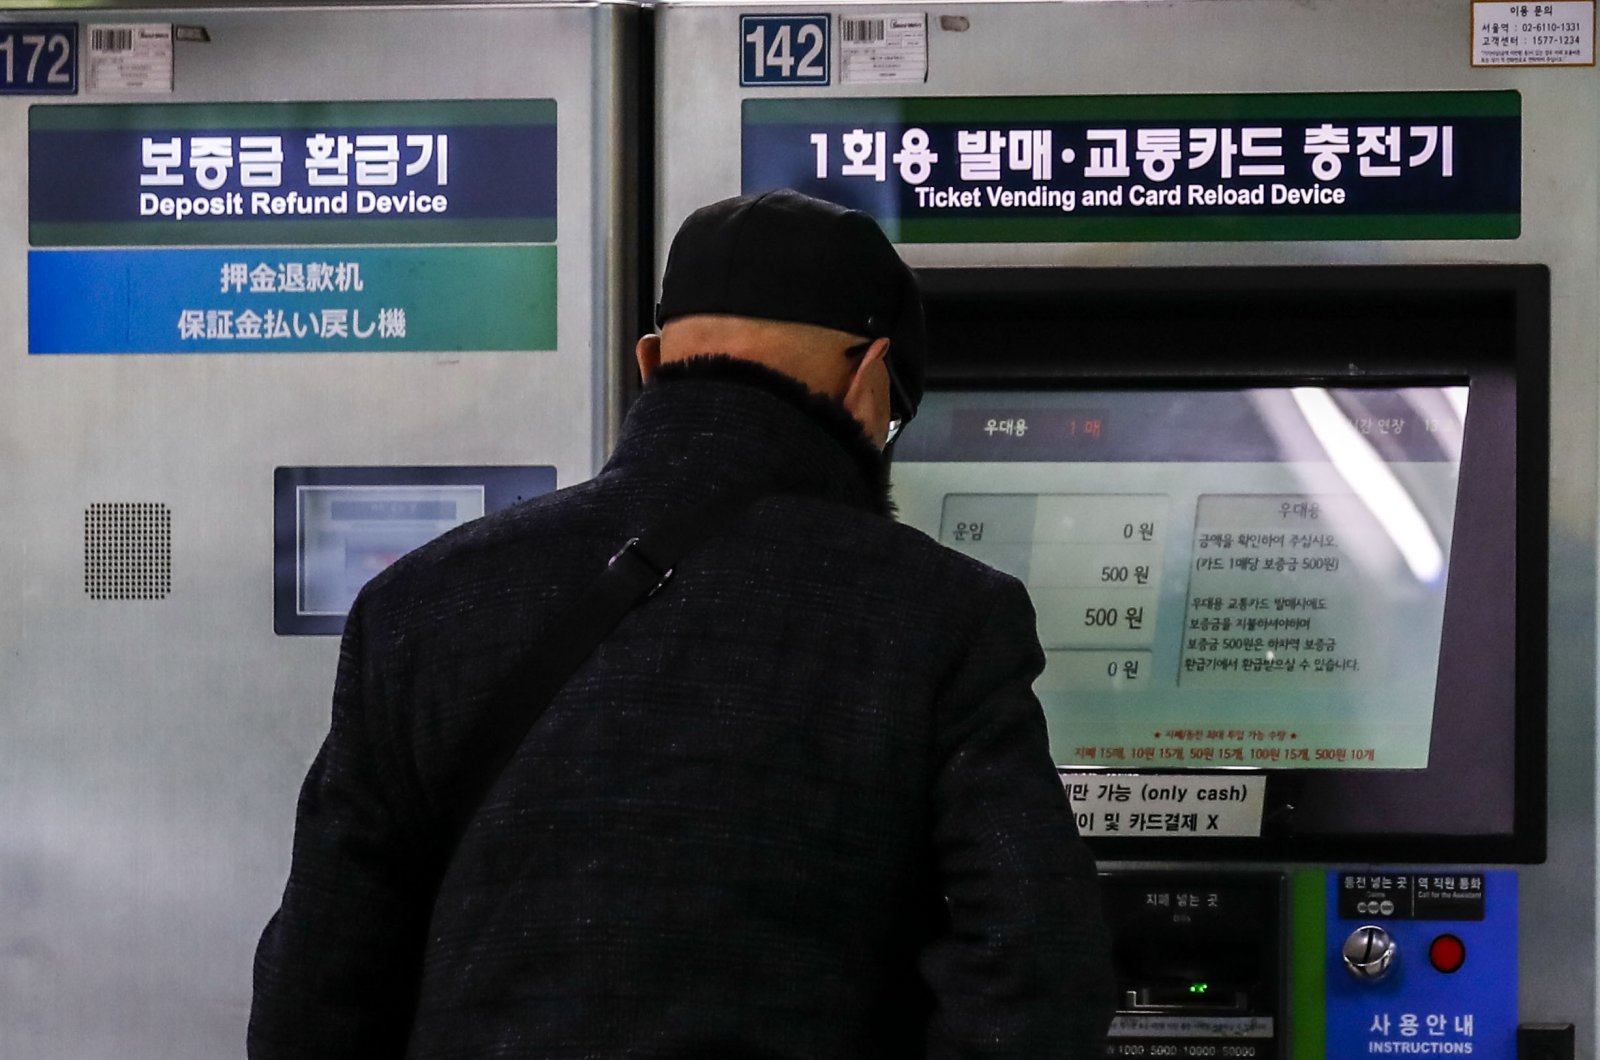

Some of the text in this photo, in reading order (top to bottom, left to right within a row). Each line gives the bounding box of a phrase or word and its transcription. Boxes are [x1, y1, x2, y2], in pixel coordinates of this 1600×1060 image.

[1510, 5, 1553, 17] 이용 문의
[1482, 22, 1509, 33] 서울역
[1522, 22, 1580, 32] 02-6110-1331
[1482, 36, 1518, 46] 고객센터
[1532, 36, 1580, 45] 1577-1234
[0, 34, 70, 83] 172
[746, 24, 824, 77] 142
[140, 133, 448, 190] 보증금 환급기
[1304, 124, 1453, 181] 충전기
[140, 190, 448, 219] Deposit Refund Device
[915, 183, 1346, 211] Ticket Vending and Card Reload Device
[220, 262, 363, 293] 押金退款机
[178, 309, 406, 340] 保証金払い戻し機
[984, 418, 1028, 437] 우대용
[1084, 419, 1102, 437] 매
[1378, 418, 1405, 434] 연장
[1278, 502, 1323, 519] 우대용
[953, 522, 1154, 541] 운임 0 원
[1198, 533, 1234, 548] 금액을
[1237, 533, 1285, 548] 확인하여
[1196, 557, 1340, 571] (카드 1매당 보증금 500원)
[1101, 565, 1149, 584] 500 원
[1227, 597, 1270, 611] 교통카드
[1084, 606, 1143, 630] 500 원
[1189, 618, 1232, 631] 보증금을
[1187, 638, 1337, 652] 보증금 500원은 하차역 보증금
[1107, 660, 1139, 680] 0 원
[1184, 658, 1238, 672] 환급기에서
[1299, 657, 1312, 671] 수
[1314, 657, 1360, 672] 있습니다.
[1190, 747, 1214, 761] 50원
[1251, 747, 1280, 761] 100원
[1315, 748, 1347, 761] 500원
[1351, 748, 1375, 761] 10개
[1098, 784, 1132, 802] 가능
[1141, 784, 1188, 803] (only
[1197, 784, 1247, 802] cash)
[1074, 812, 1219, 832] 이 및 카드결제 X
[1370, 876, 1392, 889] 넣는
[1396, 876, 1407, 889] 곳
[1418, 877, 1429, 889] 역
[1433, 877, 1455, 890] 직원
[1369, 1041, 1473, 1054] INSTRUCTIONS
